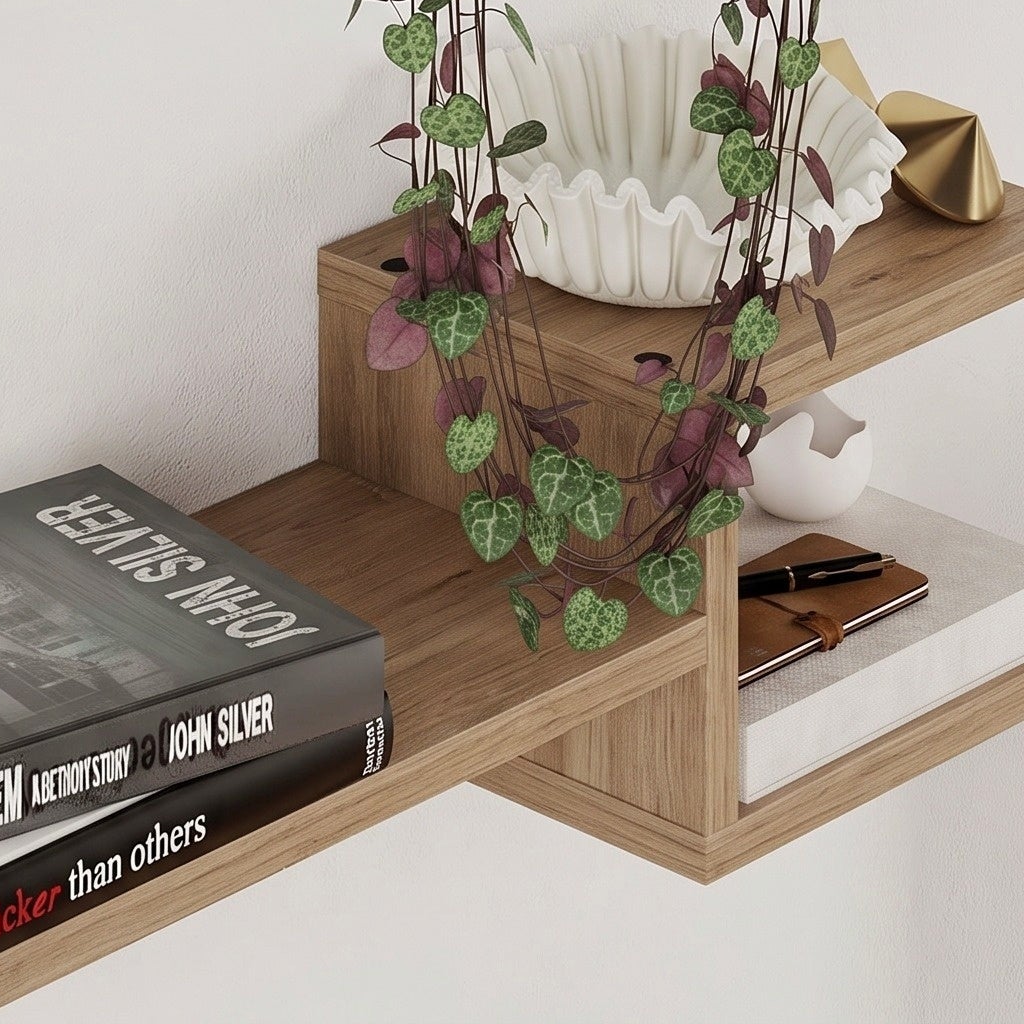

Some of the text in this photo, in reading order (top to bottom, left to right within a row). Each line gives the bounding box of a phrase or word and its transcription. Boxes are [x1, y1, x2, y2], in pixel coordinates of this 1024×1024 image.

[35, 494, 320, 649] JOHN SILVER
[169, 712, 213, 763] JOHN
[217, 693, 274, 747] SILVER
[68, 854, 122, 901] than
[130, 814, 207, 872] others
